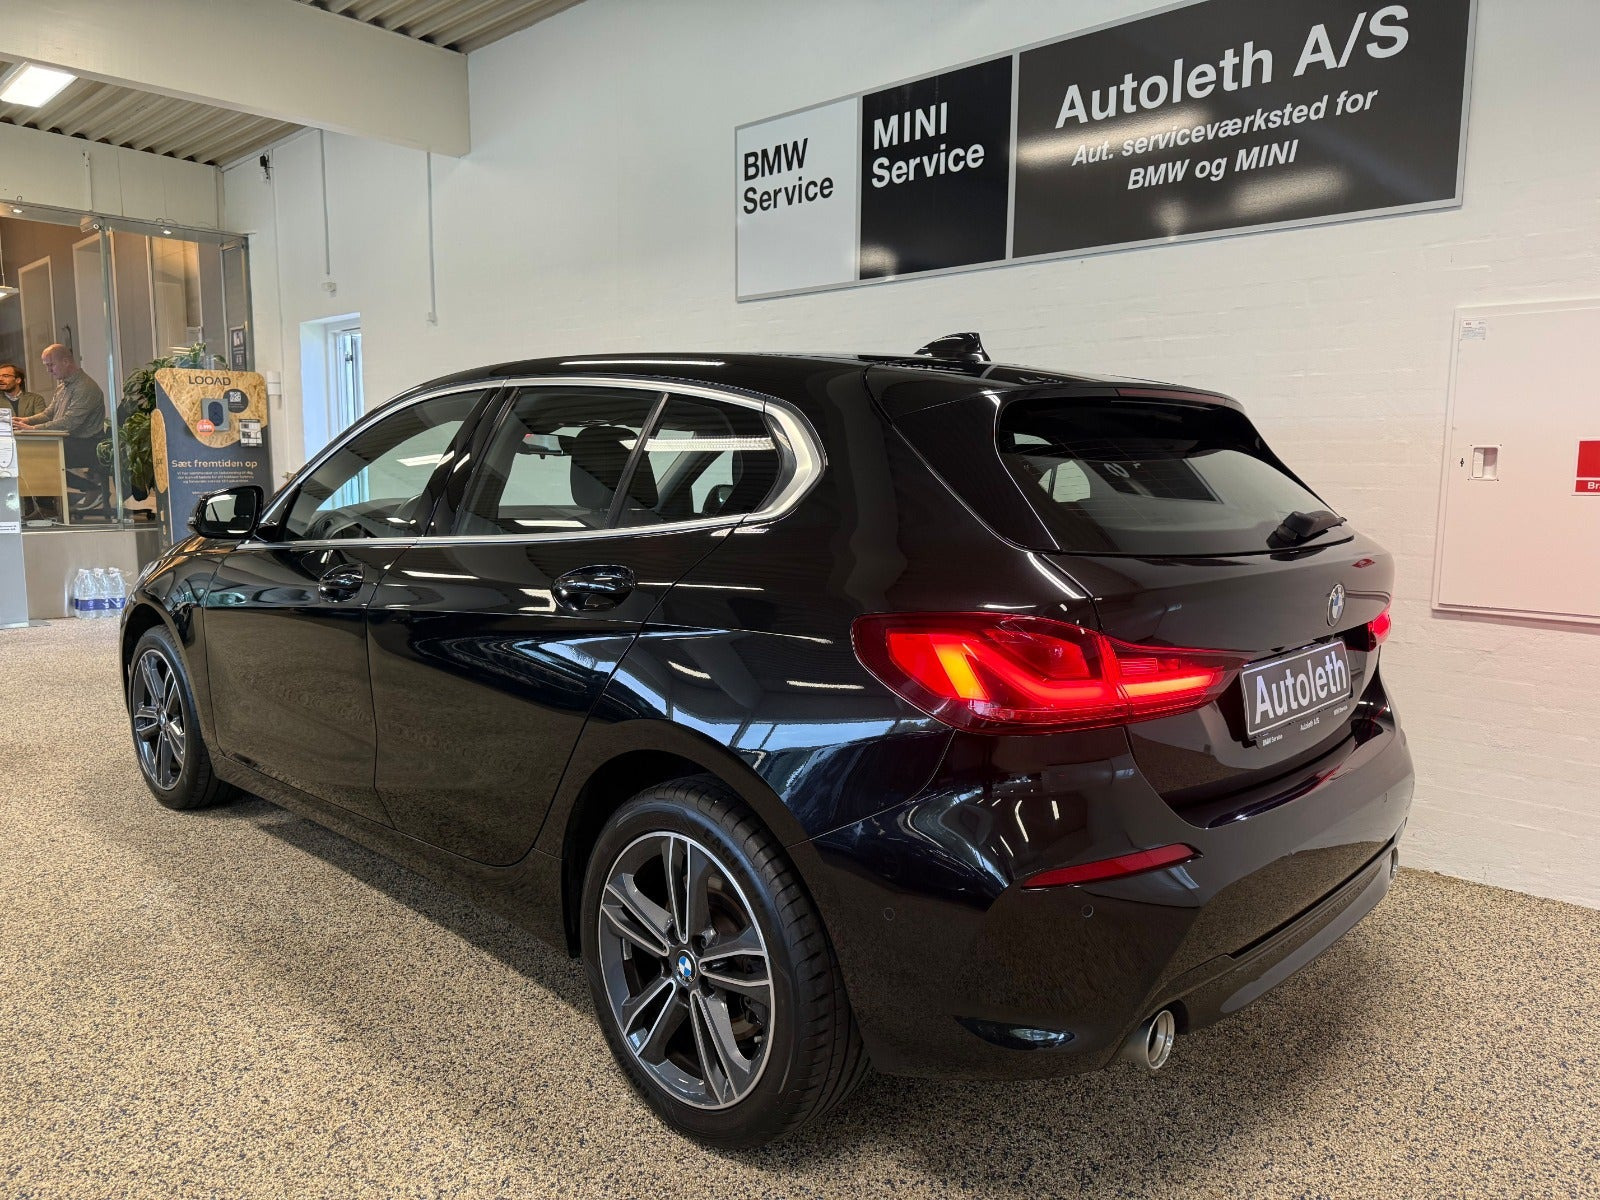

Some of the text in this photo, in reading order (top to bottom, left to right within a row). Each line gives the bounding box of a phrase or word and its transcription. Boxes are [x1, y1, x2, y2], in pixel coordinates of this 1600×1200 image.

[1054, 4, 1410, 129] Autoleth A/S
[873, 101, 948, 150] MINI
[1071, 87, 1379, 167] Aut. serviceværksted for
[744, 137, 809, 181] BMW
[871, 143, 985, 188] Service
[1127, 139, 1299, 190] BMW og MINI
[743, 175, 834, 215] Service
[188, 376, 231, 386] LOOAD
[171, 459, 192, 468] Sæt
[194, 459, 243, 468] fremtiden
[245, 461, 258, 469] op
[1587, 481, 1600, 490] Br
[1254, 651, 1347, 724] Autoleth
